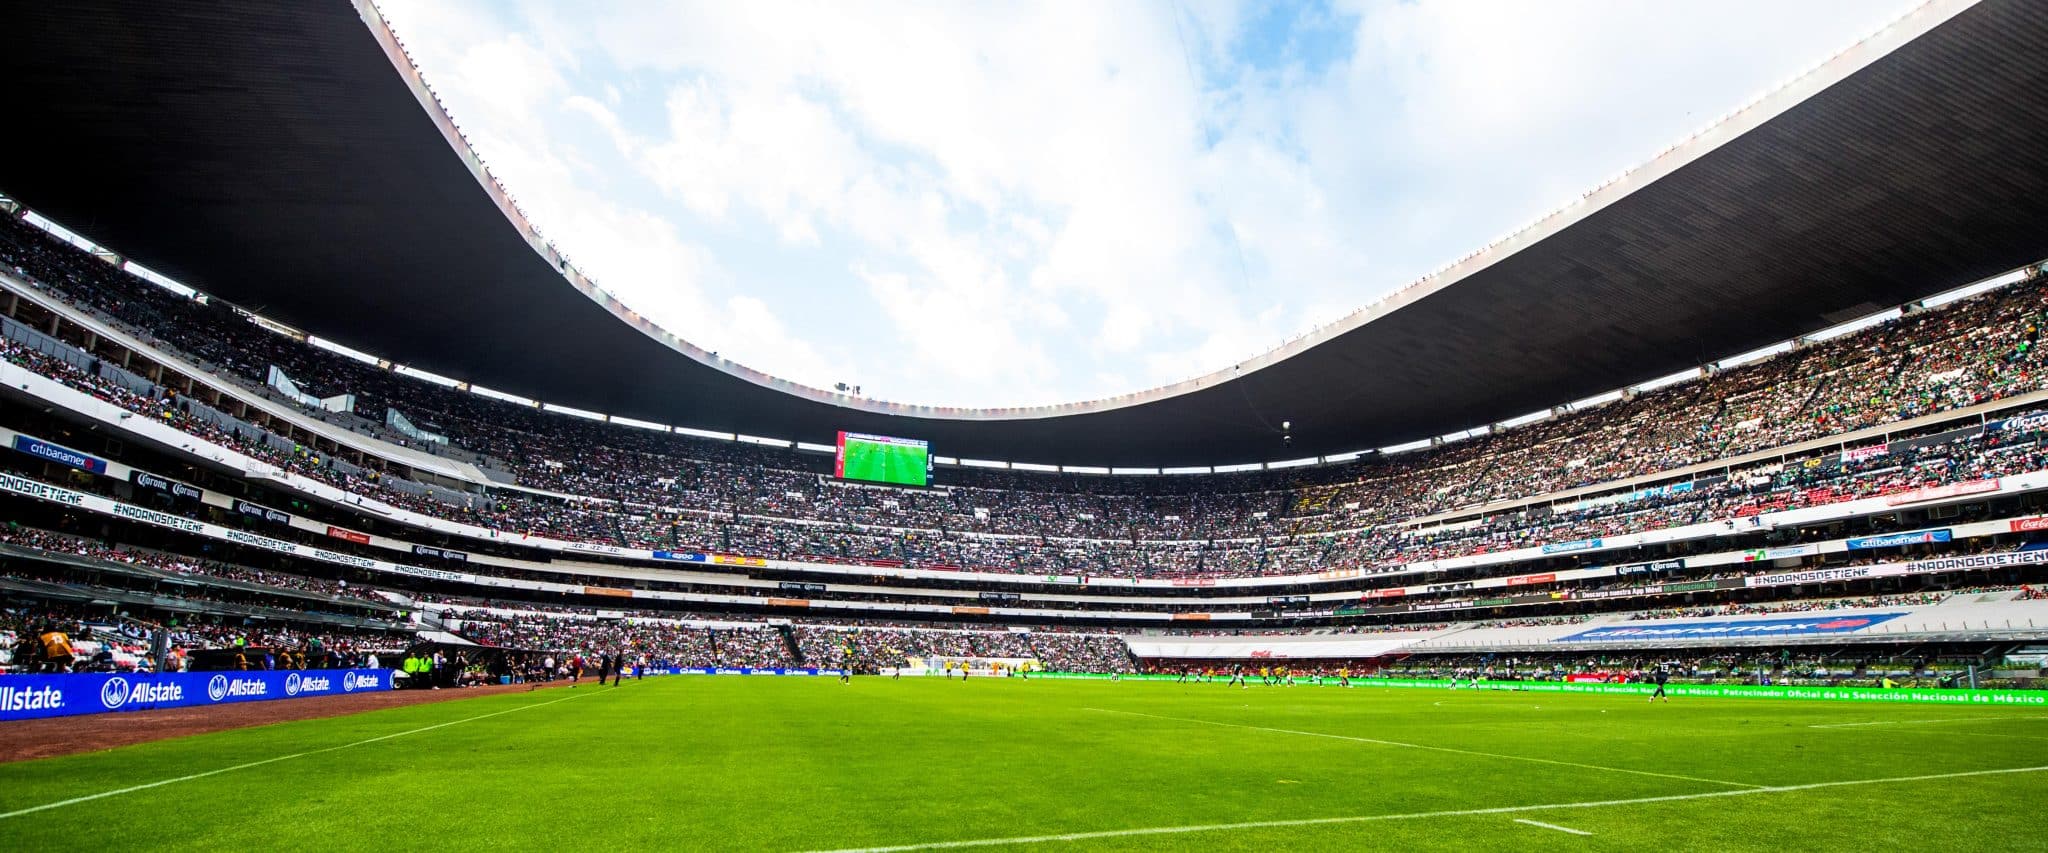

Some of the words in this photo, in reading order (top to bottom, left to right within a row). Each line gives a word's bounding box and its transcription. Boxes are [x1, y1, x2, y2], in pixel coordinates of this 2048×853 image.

[30, 443, 85, 468] citibanamex
[137, 473, 167, 490] Corona
[172, 482, 199, 498] Corona
[239, 501, 262, 516] Corona
[1860, 535, 1922, 548] citibanamex
[1619, 564, 1646, 575] Corona
[1651, 560, 1680, 571] Corona
[1906, 550, 2048, 572] #NADANOSDETIEN
[1632, 588, 1645, 597] App
[1723, 688, 1784, 697] Patrocinador
[1788, 689, 1820, 698] Oficial
[1824, 690, 1836, 699] de
[1840, 691, 1849, 699] la
[1852, 690, 1909, 701] Selección
[1912, 692, 1969, 702] Nacional
[1973, 693, 1989, 703] de
[1993, 693, 2045, 704] México
